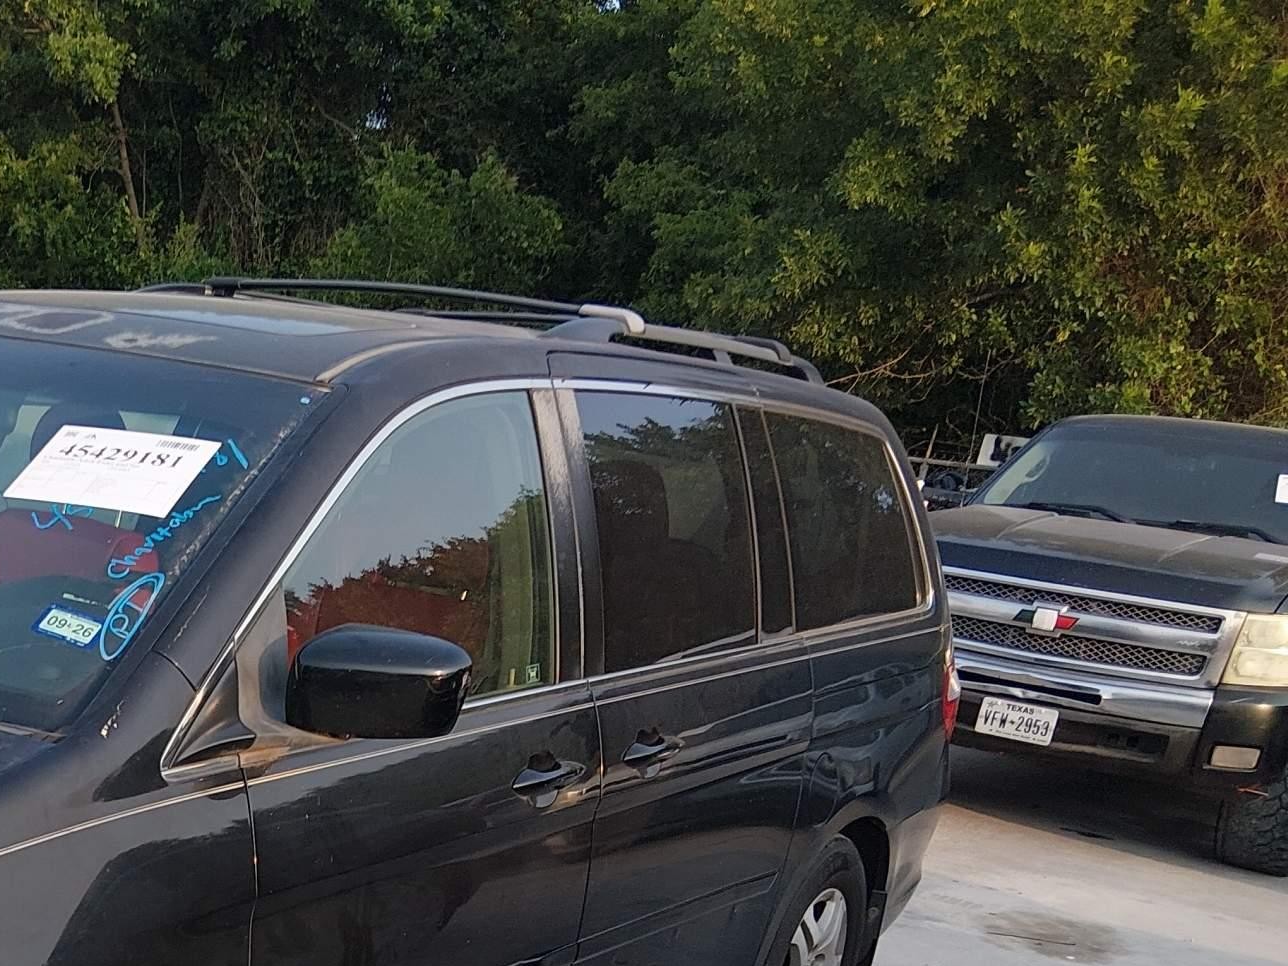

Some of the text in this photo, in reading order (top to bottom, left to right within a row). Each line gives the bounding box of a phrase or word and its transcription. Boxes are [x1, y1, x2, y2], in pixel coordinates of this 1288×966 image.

[59, 444, 184, 468] 45429181
[46, 615, 68, 629] 09
[72, 622, 93, 638] 26
[1006, 703, 1035, 715] TEXAS
